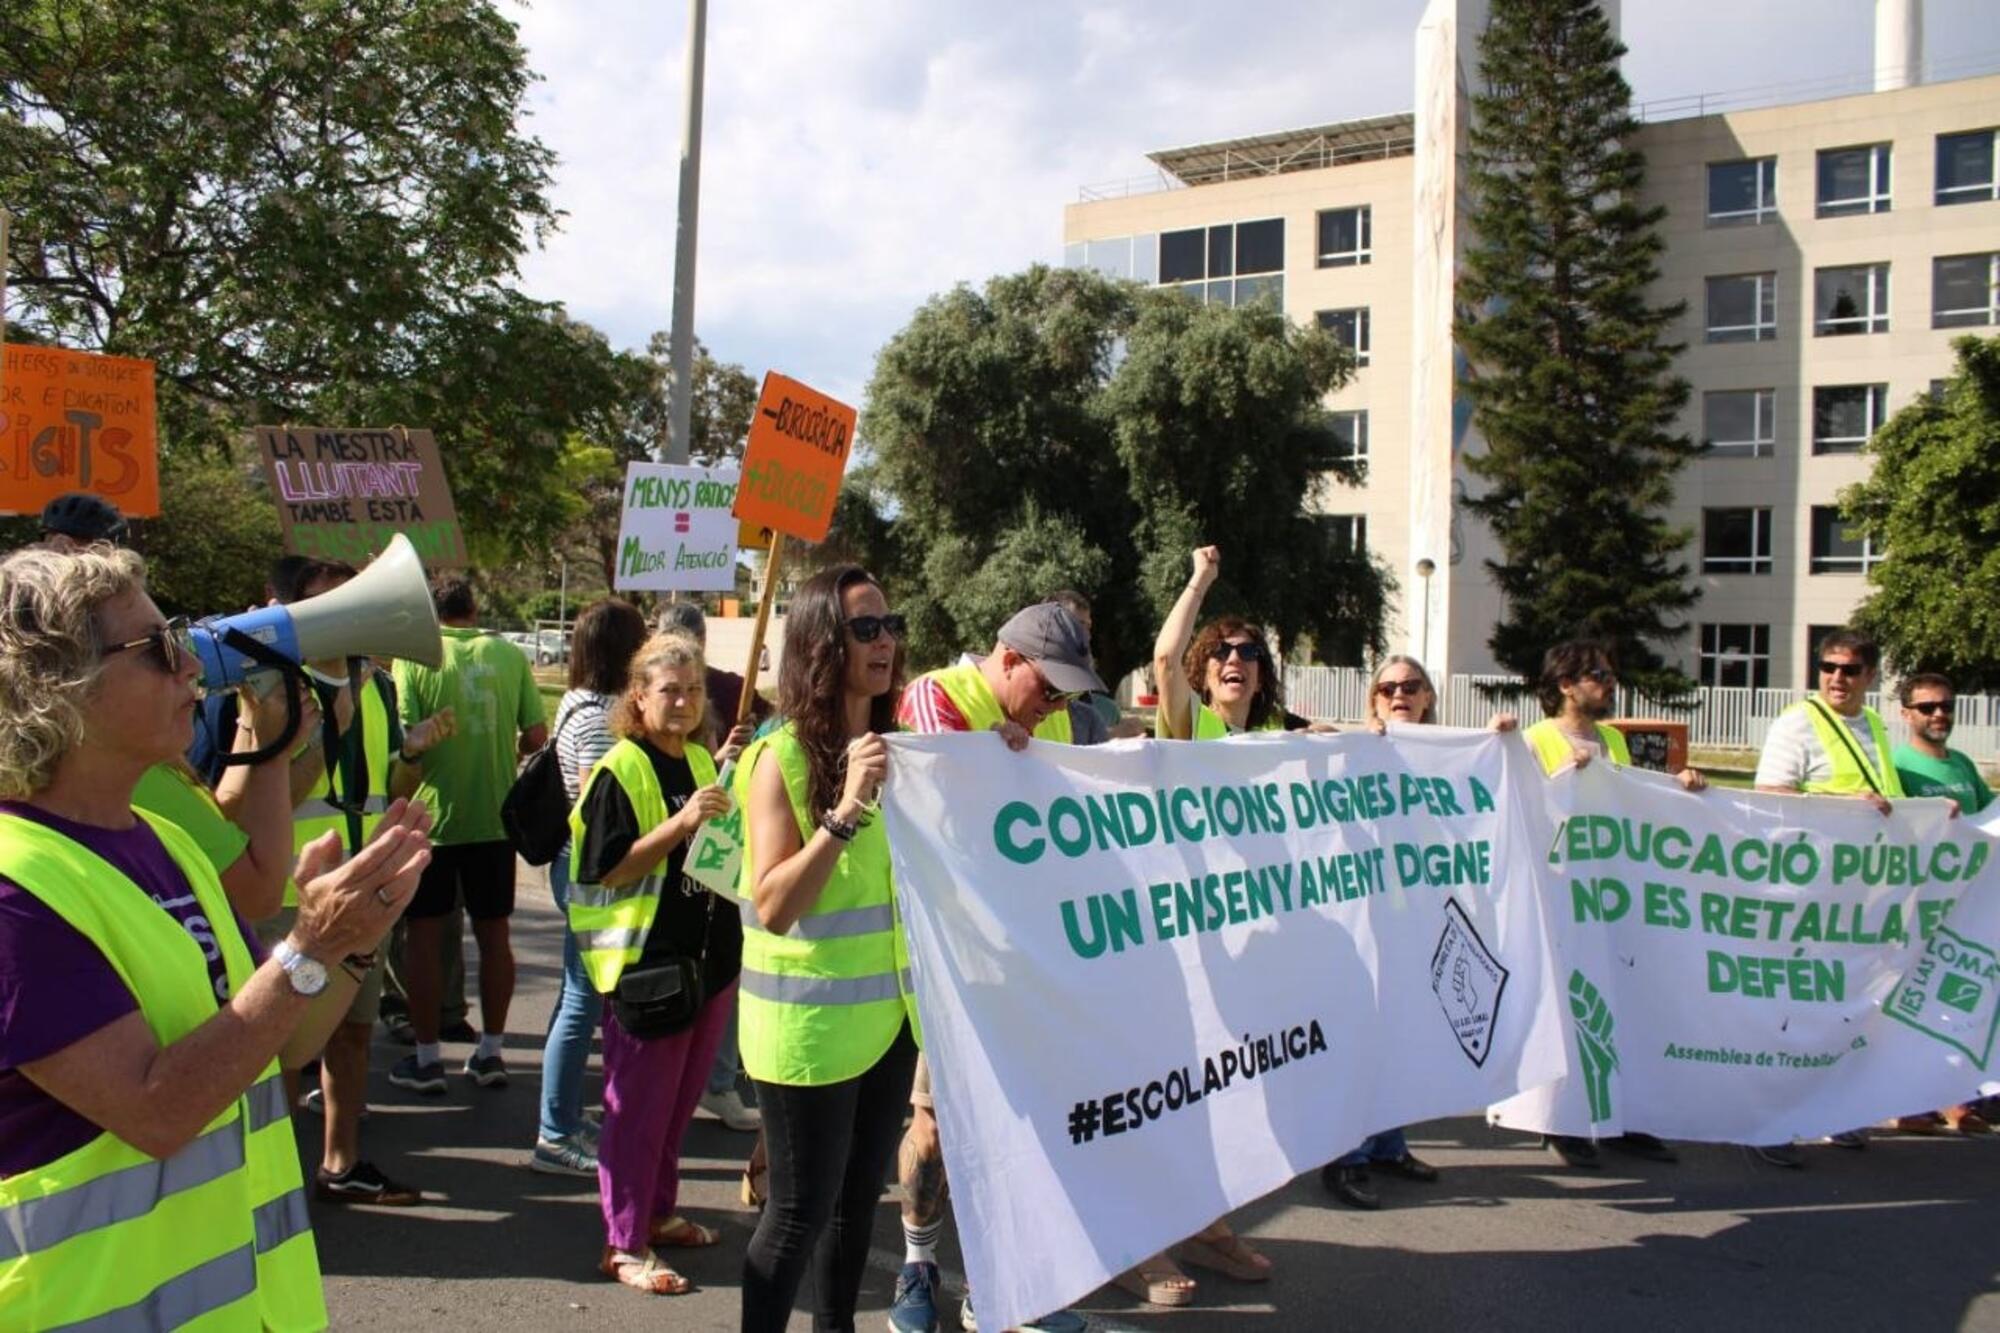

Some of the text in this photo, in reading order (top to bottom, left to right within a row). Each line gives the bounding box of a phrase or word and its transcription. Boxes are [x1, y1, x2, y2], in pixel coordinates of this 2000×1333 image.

[268, 432, 421, 461] LA MESTRA
[275, 460, 423, 501] LLUITANT
[629, 476, 691, 508] MENYS
[993, 771, 1496, 865] CONDICIONS DIGNES PER A
[1060, 840, 1492, 961] UN ENSENYAMENT DIGNE
[1570, 876, 1632, 924] NO
[1643, 881, 1692, 929] ES
[1707, 947, 1845, 1002] DEFÉN
[1898, 986, 1926, 1017] IES
[1664, 1042, 1752, 1066] Assemblea
[1755, 1050, 1774, 1068] de
[1068, 1020, 1327, 1145] #ESCOLAPÚBLICA
